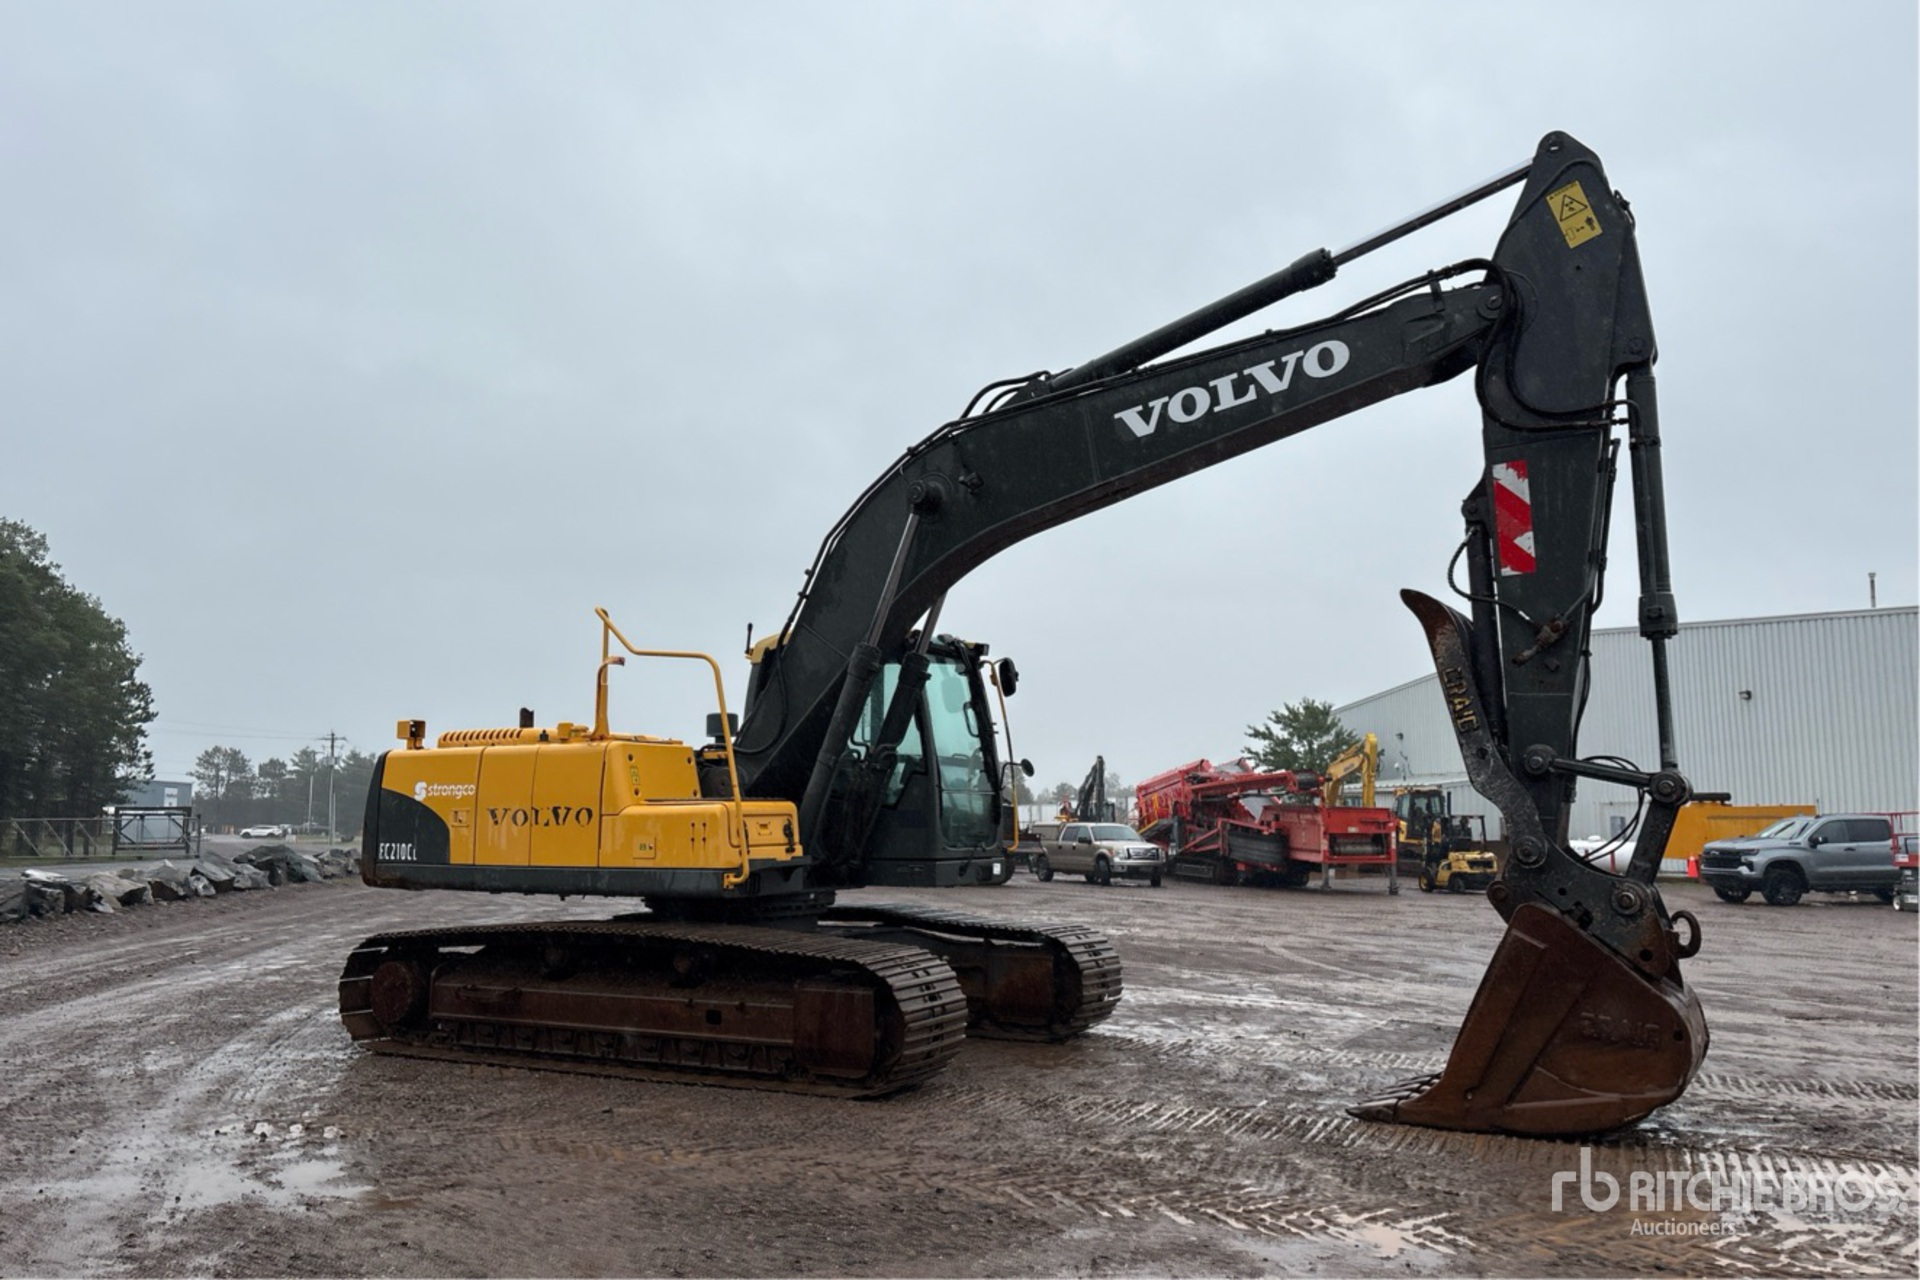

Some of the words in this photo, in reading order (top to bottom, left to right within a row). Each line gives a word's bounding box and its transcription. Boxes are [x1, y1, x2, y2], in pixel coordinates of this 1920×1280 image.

[1114, 340, 1350, 438] VOLVO
[427, 783, 476, 799] strongco
[486, 806, 594, 828] VOLVO
